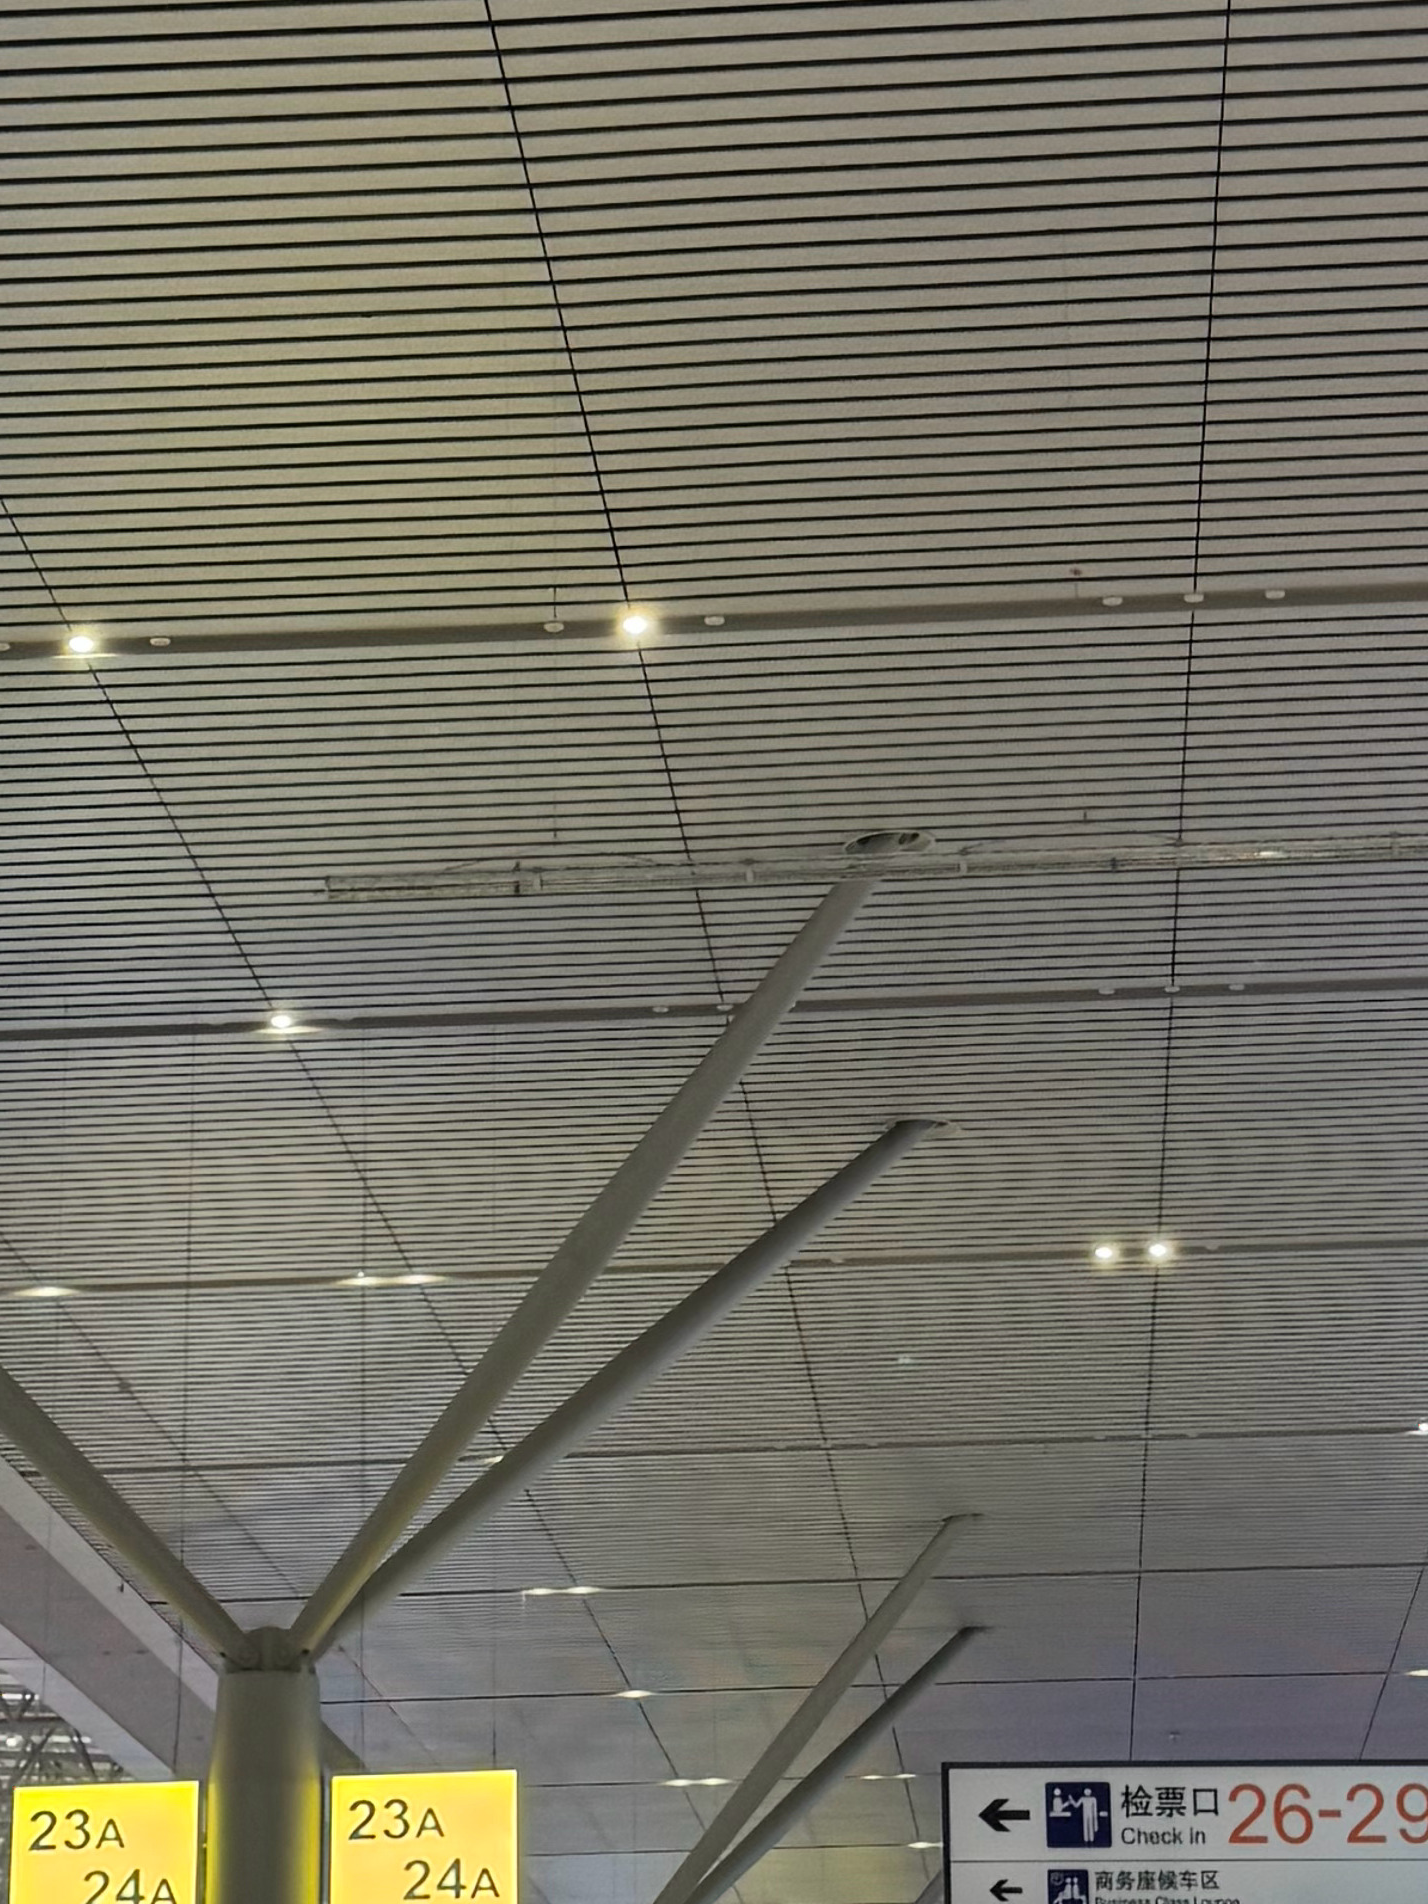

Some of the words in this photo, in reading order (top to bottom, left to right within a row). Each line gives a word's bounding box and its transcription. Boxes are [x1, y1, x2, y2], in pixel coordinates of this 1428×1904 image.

[348, 1799, 445, 1841] 23A
[1120, 1784, 1220, 1819] 检票口
[28, 1809, 126, 1851] 23A
[1121, 1826, 1184, 1846] Check
[402, 1858, 500, 1901] 24A
[1094, 1869, 1220, 1892] 商务座候车区
